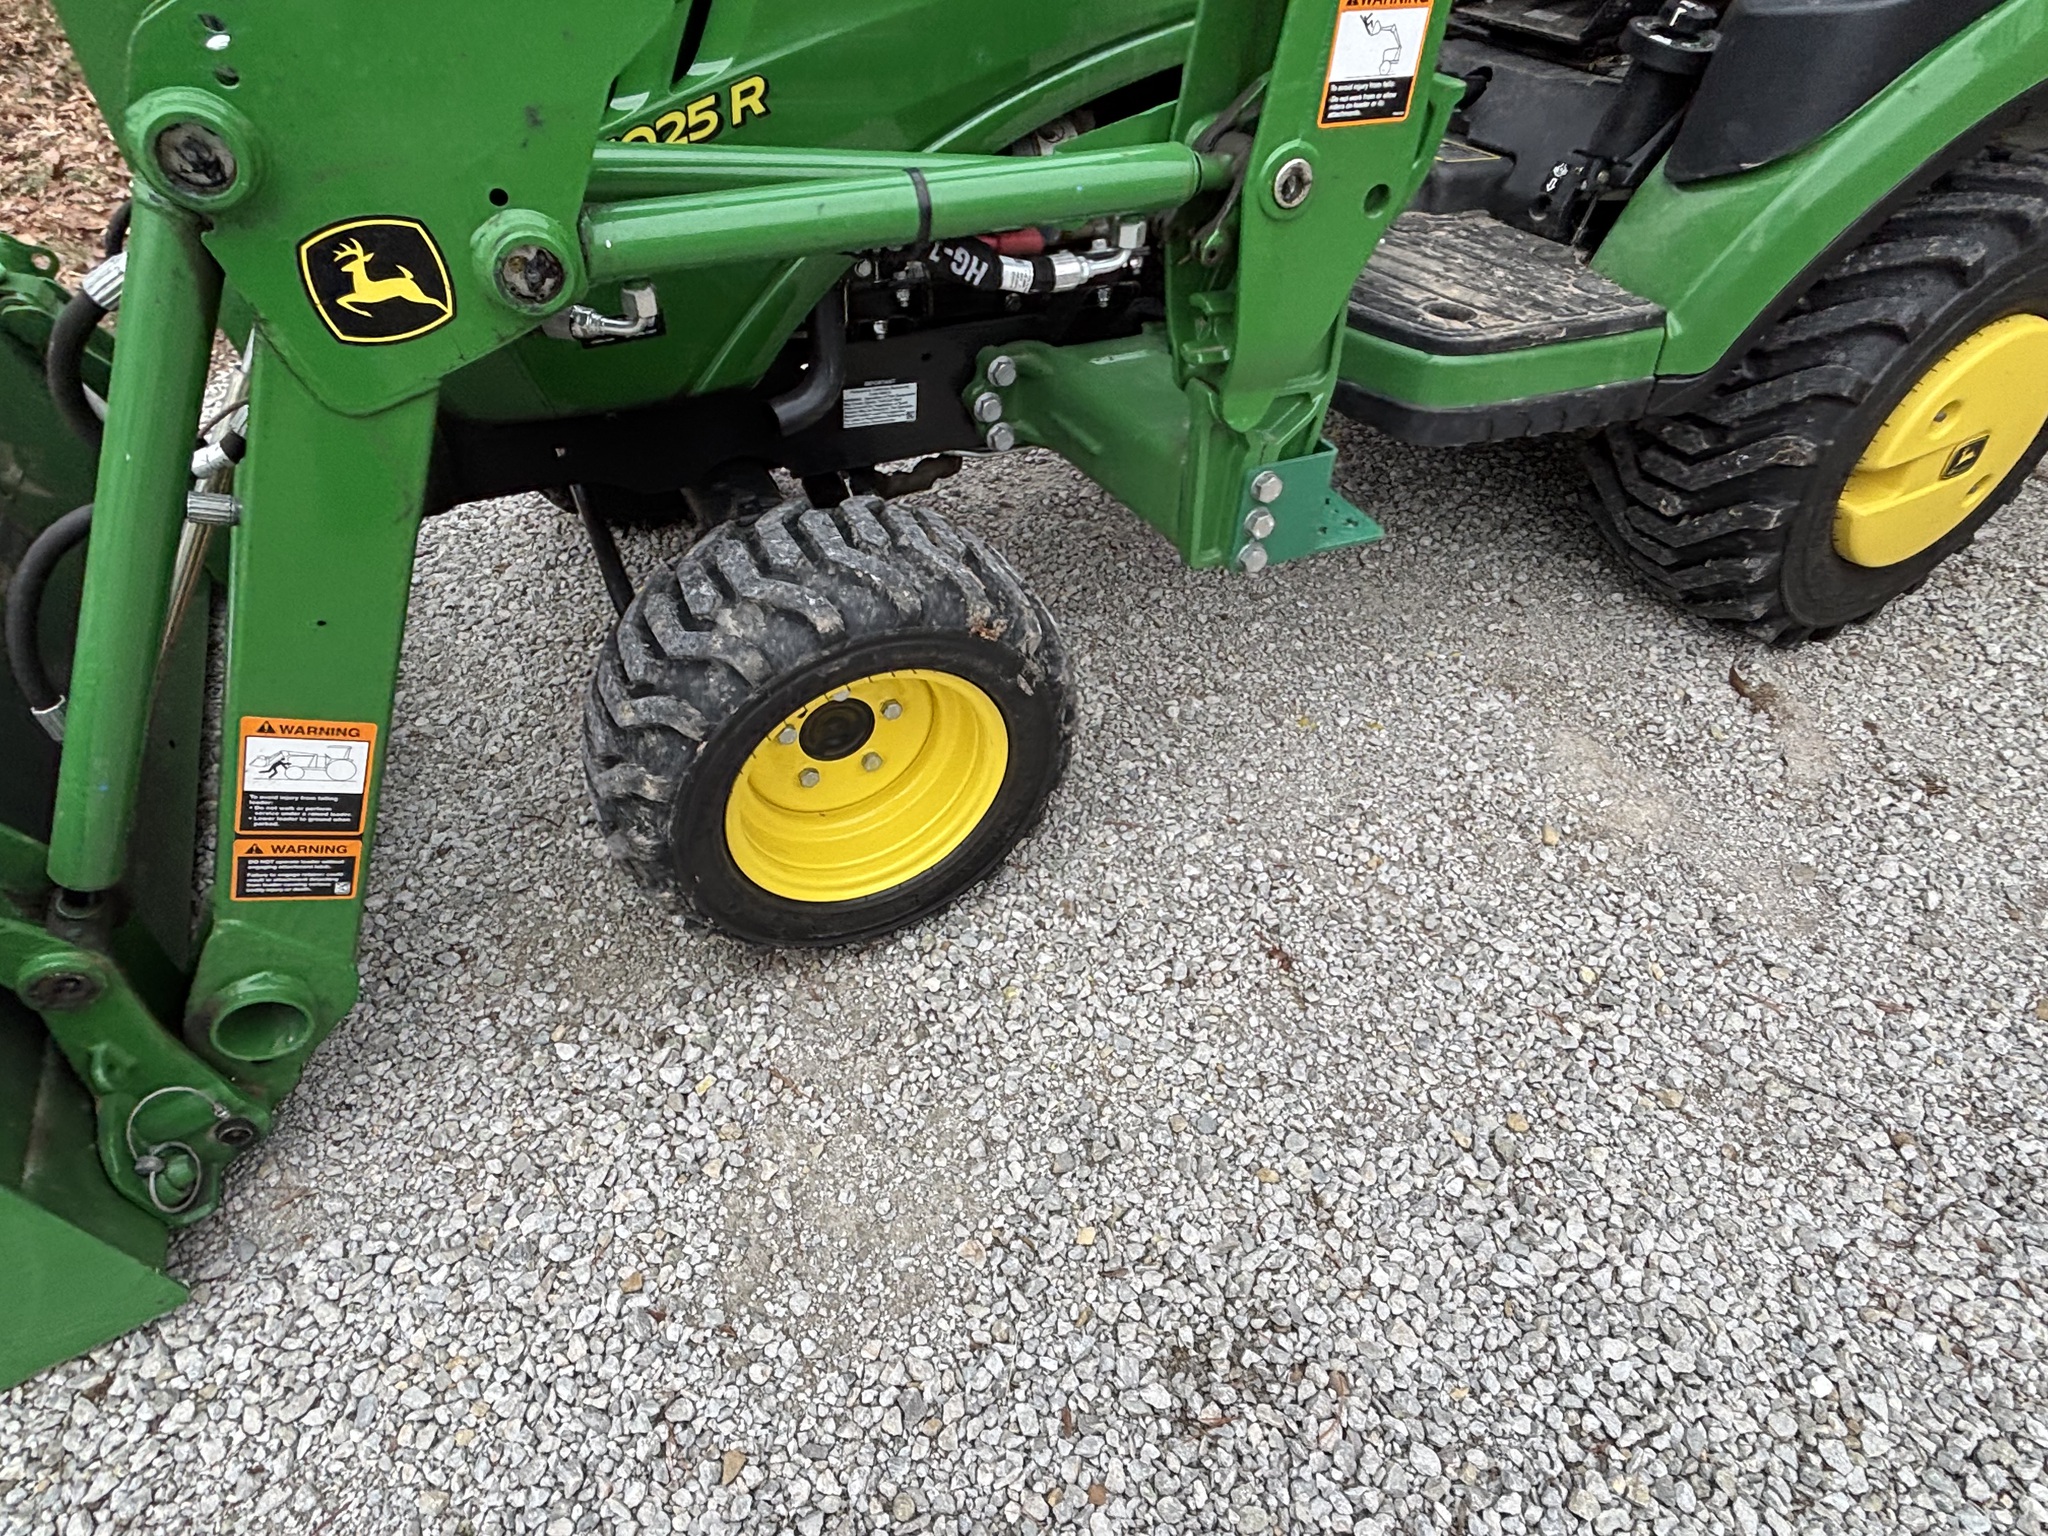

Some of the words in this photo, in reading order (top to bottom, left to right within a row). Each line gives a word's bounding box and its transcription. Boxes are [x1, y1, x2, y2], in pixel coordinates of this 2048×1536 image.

[609, 93, 721, 144] 25
[730, 75, 768, 126] R
[279, 724, 360, 738] WARNING
[271, 844, 348, 854] WARNING
